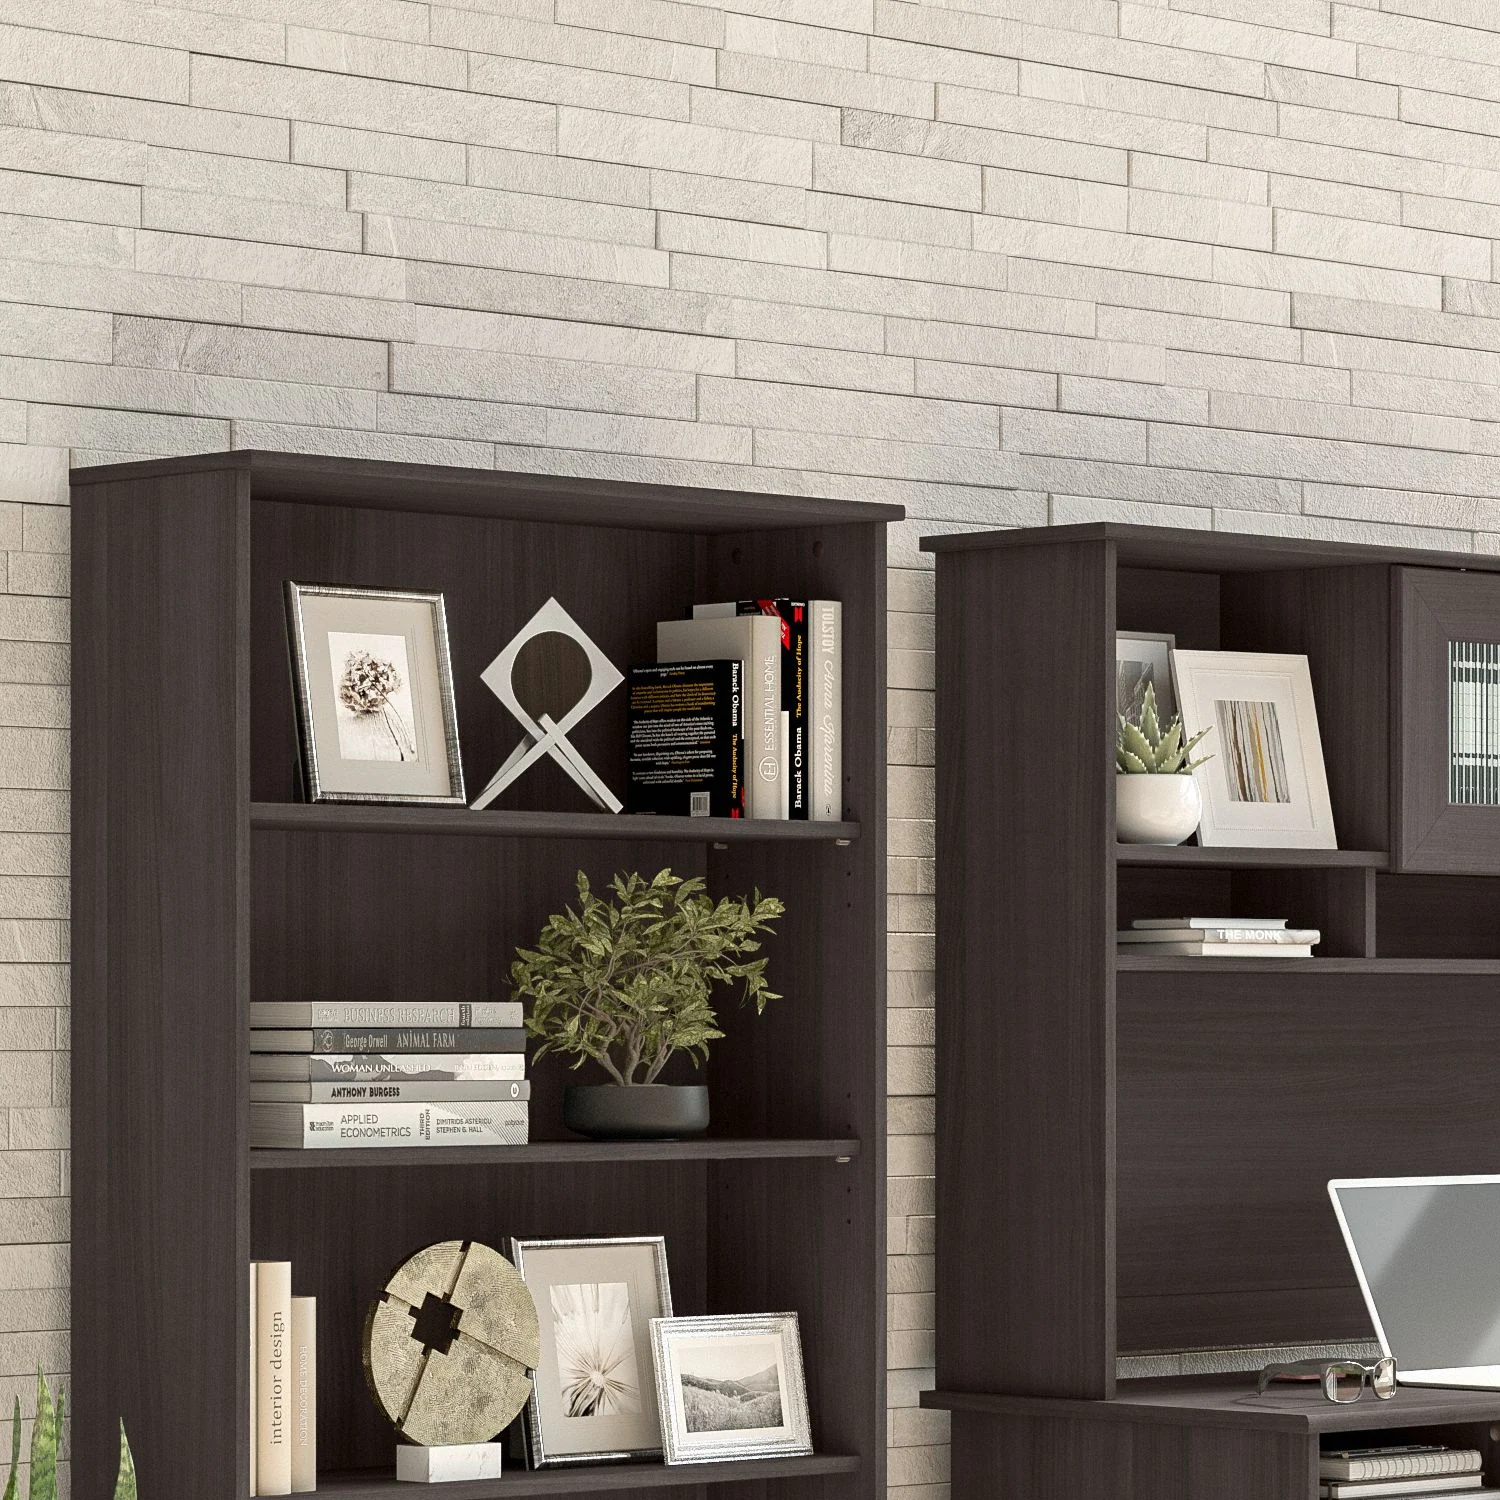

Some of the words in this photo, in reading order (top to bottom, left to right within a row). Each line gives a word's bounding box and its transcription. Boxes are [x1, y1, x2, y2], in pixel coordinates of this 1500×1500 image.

[795, 634, 803, 655] Hope
[822, 607, 835, 655] TOLSTOY
[764, 655, 776, 692] HOME
[795, 656, 802, 666] of
[731, 662, 739, 693] Barack
[795, 668, 803, 701] Audacity
[823, 660, 835, 711] Anna
[731, 694, 740, 727] Obama
[764, 694, 776, 751] ESSENTIAL
[731, 746, 739, 774] Audacity
[794, 727, 802, 768] Obama
[820, 715, 836, 797] Karenina
[730, 781, 738, 799] Hope
[794, 770, 802, 809] Barack
[1216, 930, 1242, 940] THE
[1245, 930, 1281, 940] MONK
[344, 1007, 397, 1023] BUSINESS
[399, 1008, 455, 1023] RESEARCH
[345, 1034, 367, 1052] George
[368, 1034, 388, 1048] Orwell
[397, 1031, 431, 1048] ANIMAL
[433, 1033, 456, 1048] FARM
[331, 1064, 373, 1073] WOMAN
[376, 1064, 432, 1073] UNLEASHED
[331, 1087, 367, 1098] ANTHONY
[369, 1087, 400, 1097] BURGESS
[340, 1114, 379, 1125] APPLIED
[340, 1126, 412, 1138] ECONOMETRICS
[270, 1311, 285, 1369] design
[299, 1345, 308, 1377] HOME
[270, 1375, 283, 1444] interior
[299, 1380, 309, 1446] DECORATION
